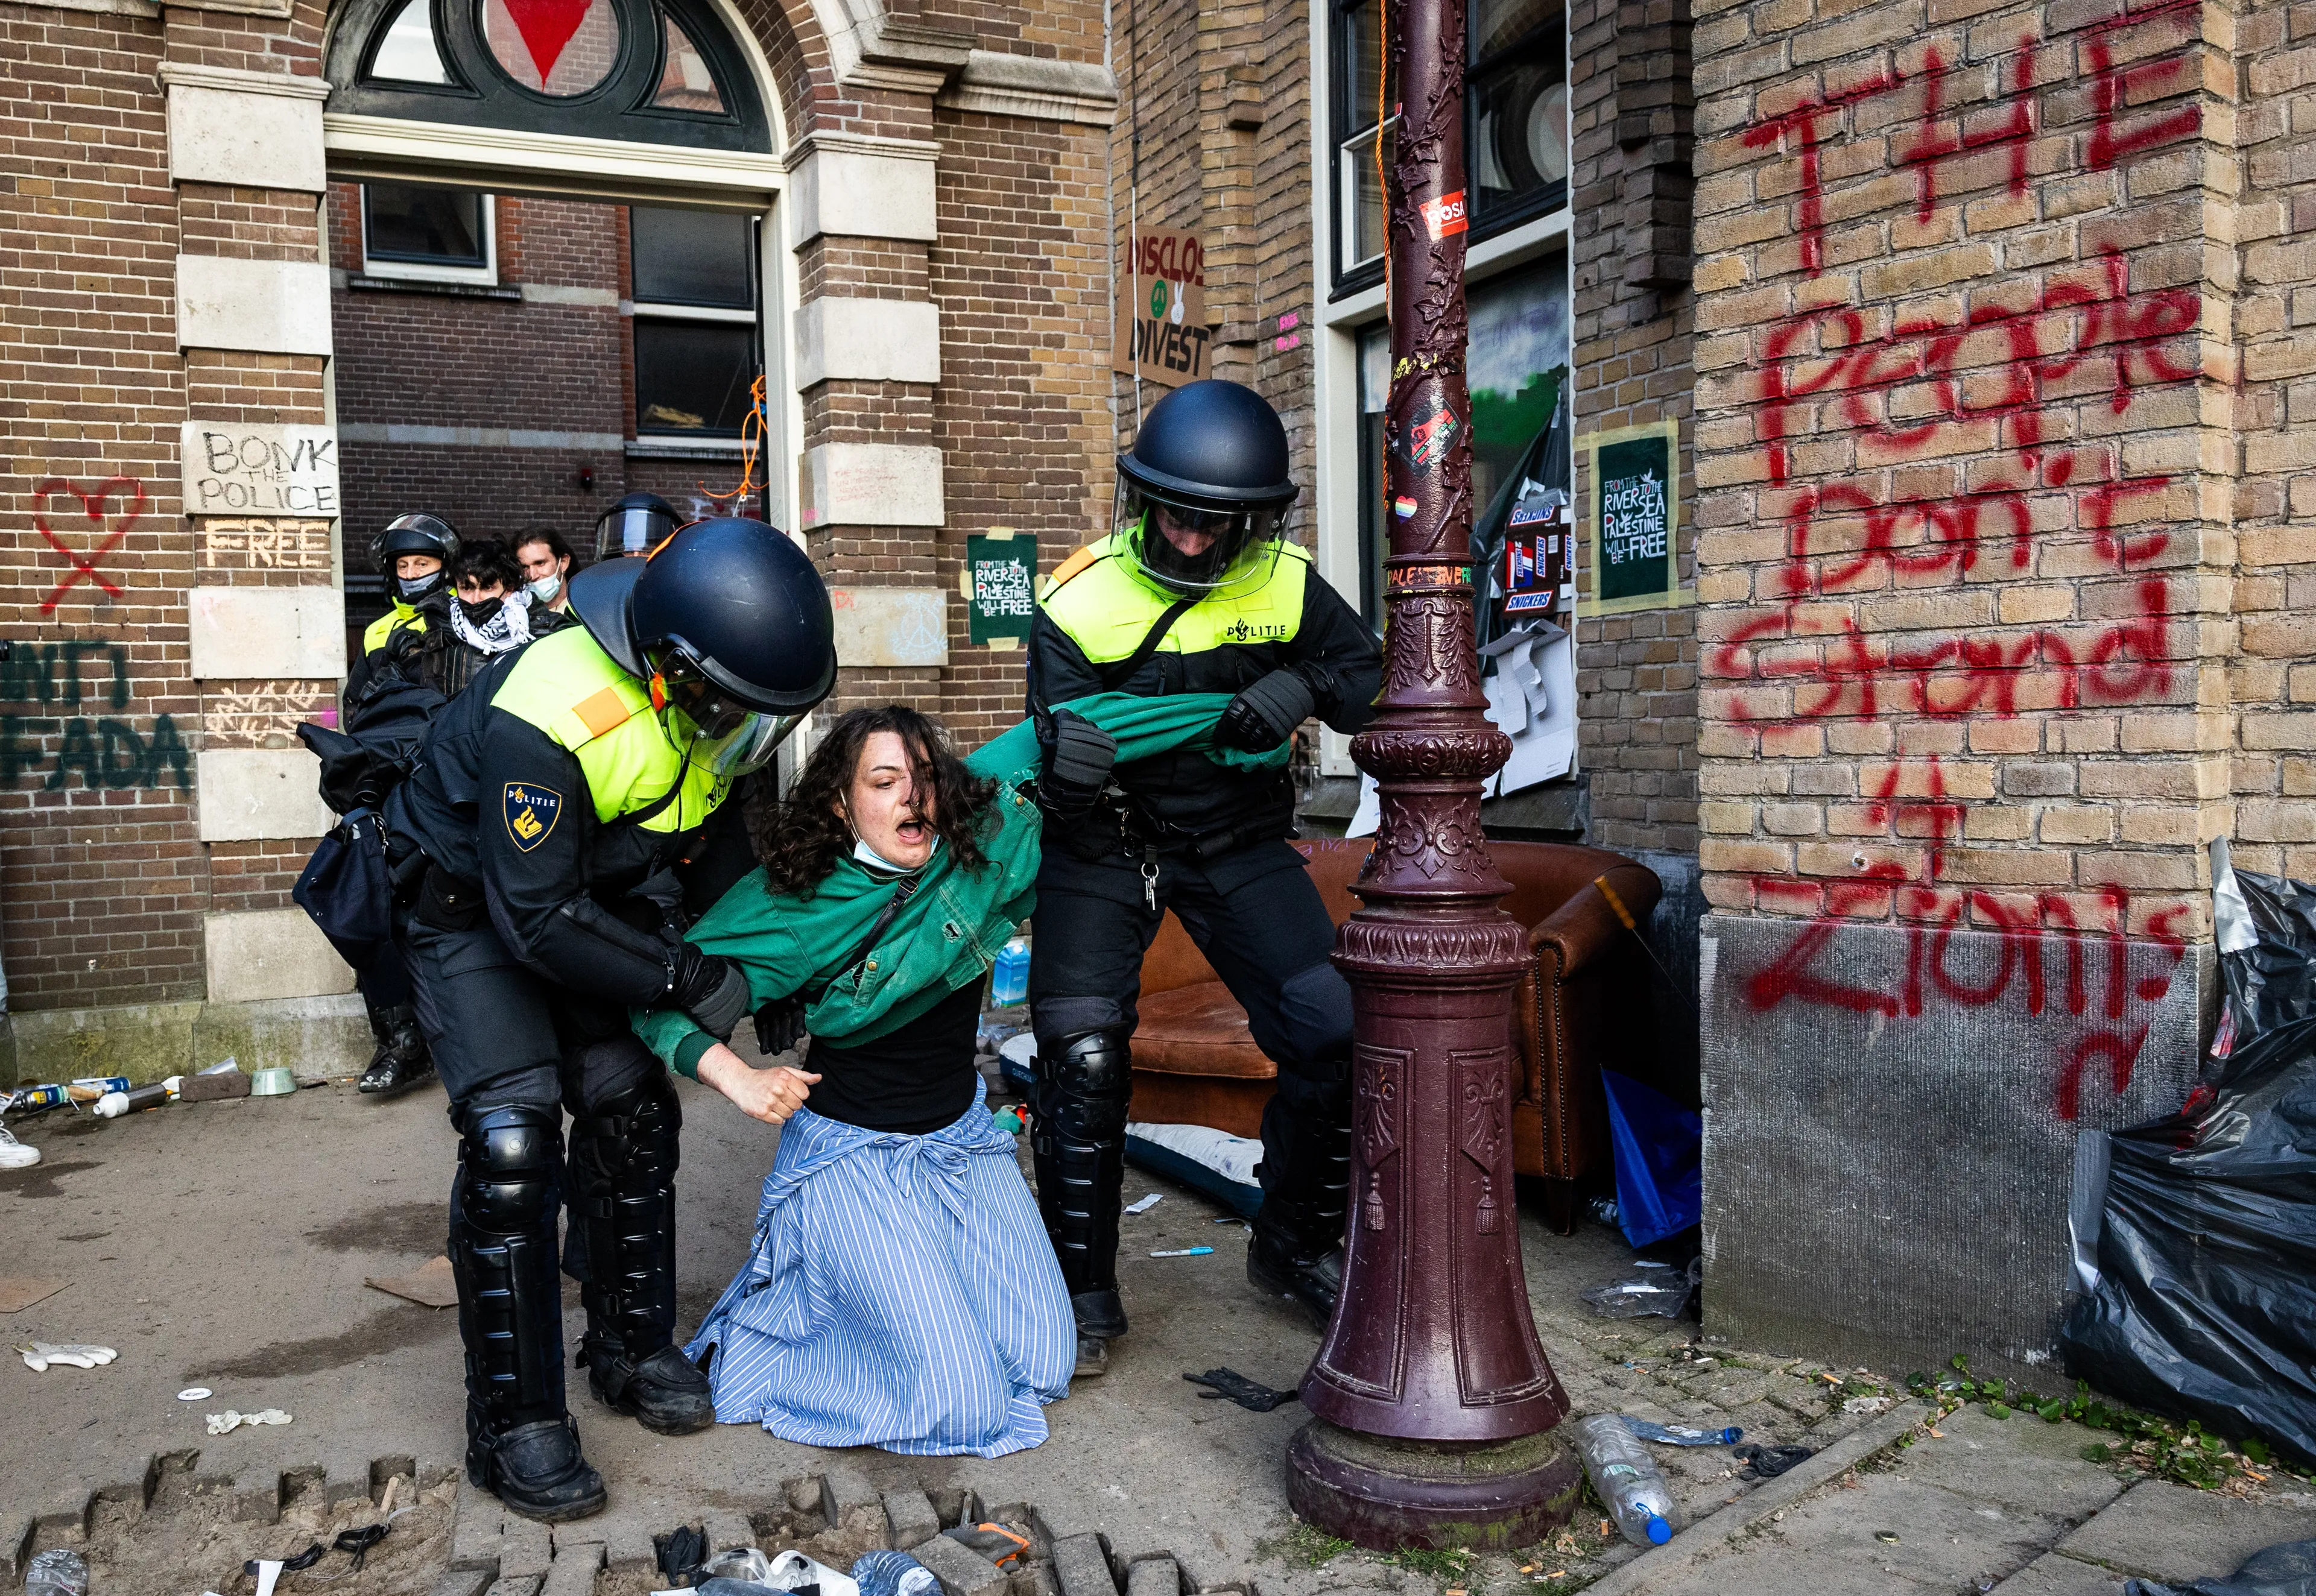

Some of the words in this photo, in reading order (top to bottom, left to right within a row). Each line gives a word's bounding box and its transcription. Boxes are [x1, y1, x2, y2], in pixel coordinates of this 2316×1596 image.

[1743, 0, 2203, 277] THE
[1426, 201, 1464, 227] ROSA
[1128, 317, 1209, 377] DIVEST
[1762, 242, 2204, 487] People
[202, 432, 336, 475] BONK
[1413, 446, 1426, 460] FROM
[241, 468, 290, 482] THE
[1604, 481, 1624, 494] FROM
[1624, 476, 1639, 489] THE
[1641, 484, 1650, 495] TO
[1650, 479, 1662, 493] THE
[197, 478, 337, 511] POLICE
[1604, 488, 1639, 513] RIVER
[1635, 493, 1665, 519] SEA
[1604, 513, 1663, 539] PALESTINE
[205, 519, 330, 568] FREE
[1605, 539, 1630, 554] WILL
[1611, 551, 1624, 564] BE
[1630, 531, 1666, 561] FREE
[975, 560, 994, 569] FROM
[994, 560, 1007, 569] THE
[1018, 566, 1028, 575] THE
[975, 569, 1008, 582] RIVER
[1005, 574, 1031, 589] SEA
[976, 582, 1030, 600] PALESTINE
[977, 600, 1001, 610] WILL
[984, 607, 997, 617] BE
[1001, 599, 1033, 616] FREE
[1508, 593, 1550, 609] SNICKERS
[1226, 625, 1286, 642] POLITIE
[1710, 572, 2171, 736] Stand
[508, 790, 556, 807] POLITIE
[1866, 744, 1964, 879] 4
